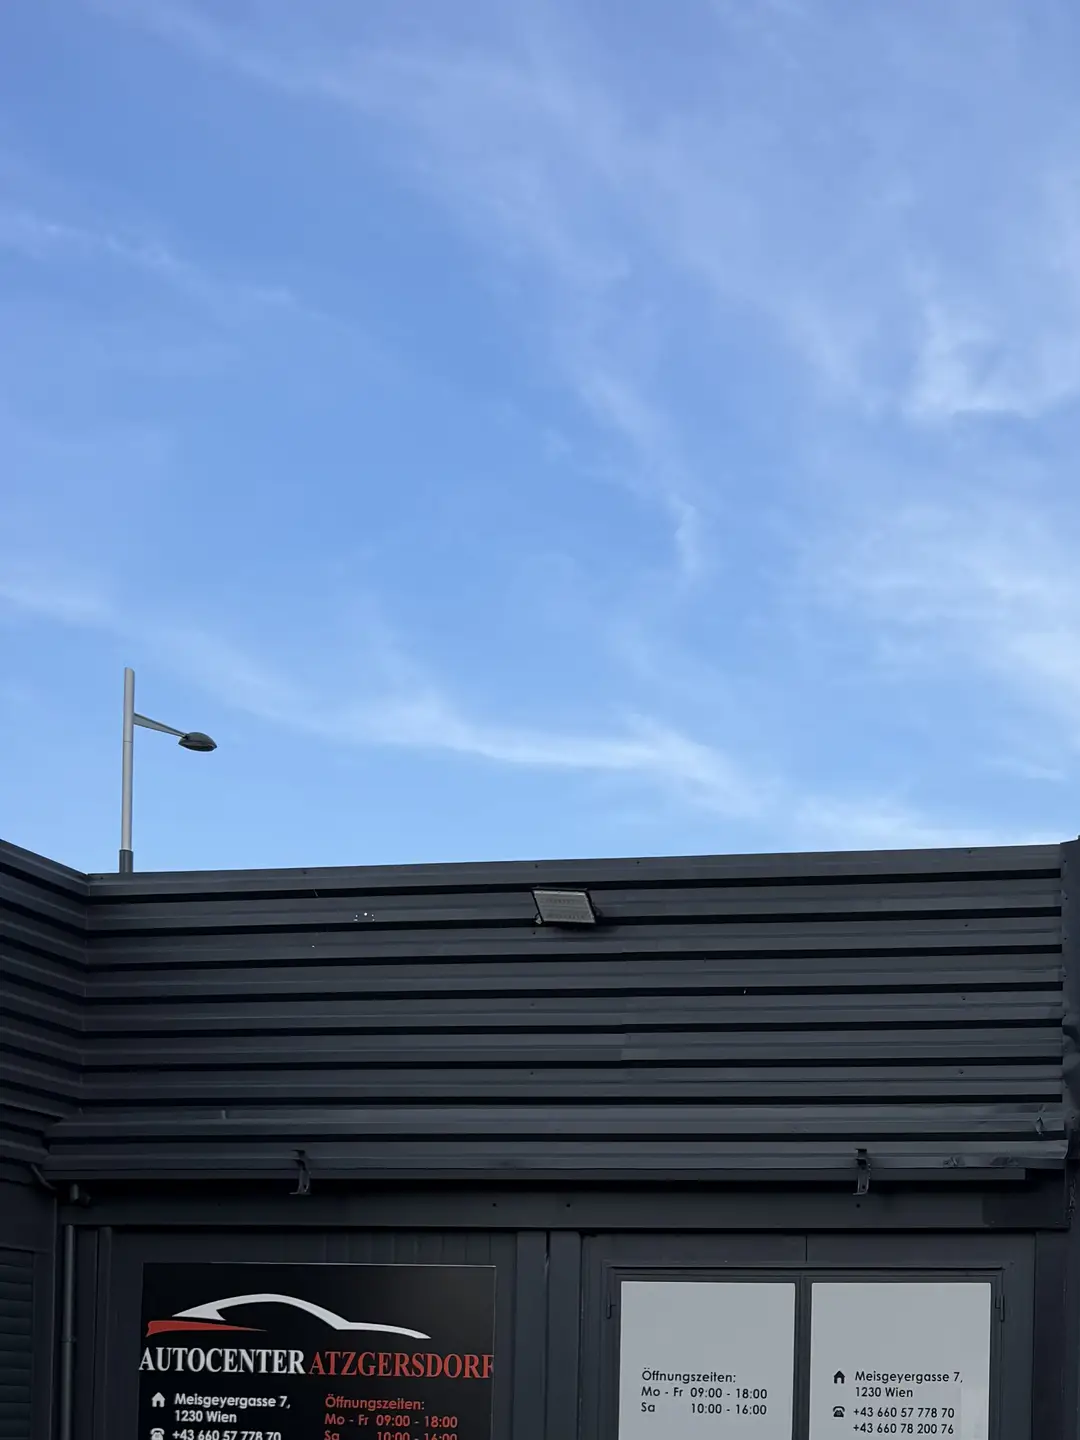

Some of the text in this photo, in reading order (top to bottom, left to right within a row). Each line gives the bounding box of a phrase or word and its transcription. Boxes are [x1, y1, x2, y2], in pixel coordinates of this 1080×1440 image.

[139, 1346, 495, 1379] AUTOCENTER ATZGERSDORF
[641, 1367, 736, 1384] Öffnungszeiten:
[854, 1370, 963, 1384] Meisgeyergasse 7,
[641, 1386, 661, 1397] Mo
[673, 1387, 684, 1397] Fr
[690, 1387, 723, 1398] 09:00
[736, 1388, 768, 1399] 18:00
[855, 1386, 913, 1398] 1230 Wien
[174, 1393, 291, 1409] Meisgeyergasse 7,
[325, 1394, 425, 1411] Öffnungszeiten:
[641, 1402, 656, 1413] Sa
[691, 1403, 722, 1414] 10:00
[736, 1404, 767, 1415] 16:00
[853, 1406, 955, 1419] +43 660 57 778 70
[174, 1409, 237, 1423] 1230 Wien
[324, 1413, 345, 1426] Mo
[358, 1414, 369, 1426] Fr
[375, 1414, 411, 1427] 09:00
[424, 1416, 458, 1428] 18:00
[172, 1428, 194, 1440] +43
[852, 1422, 955, 1435] +43 660 78 200 76
